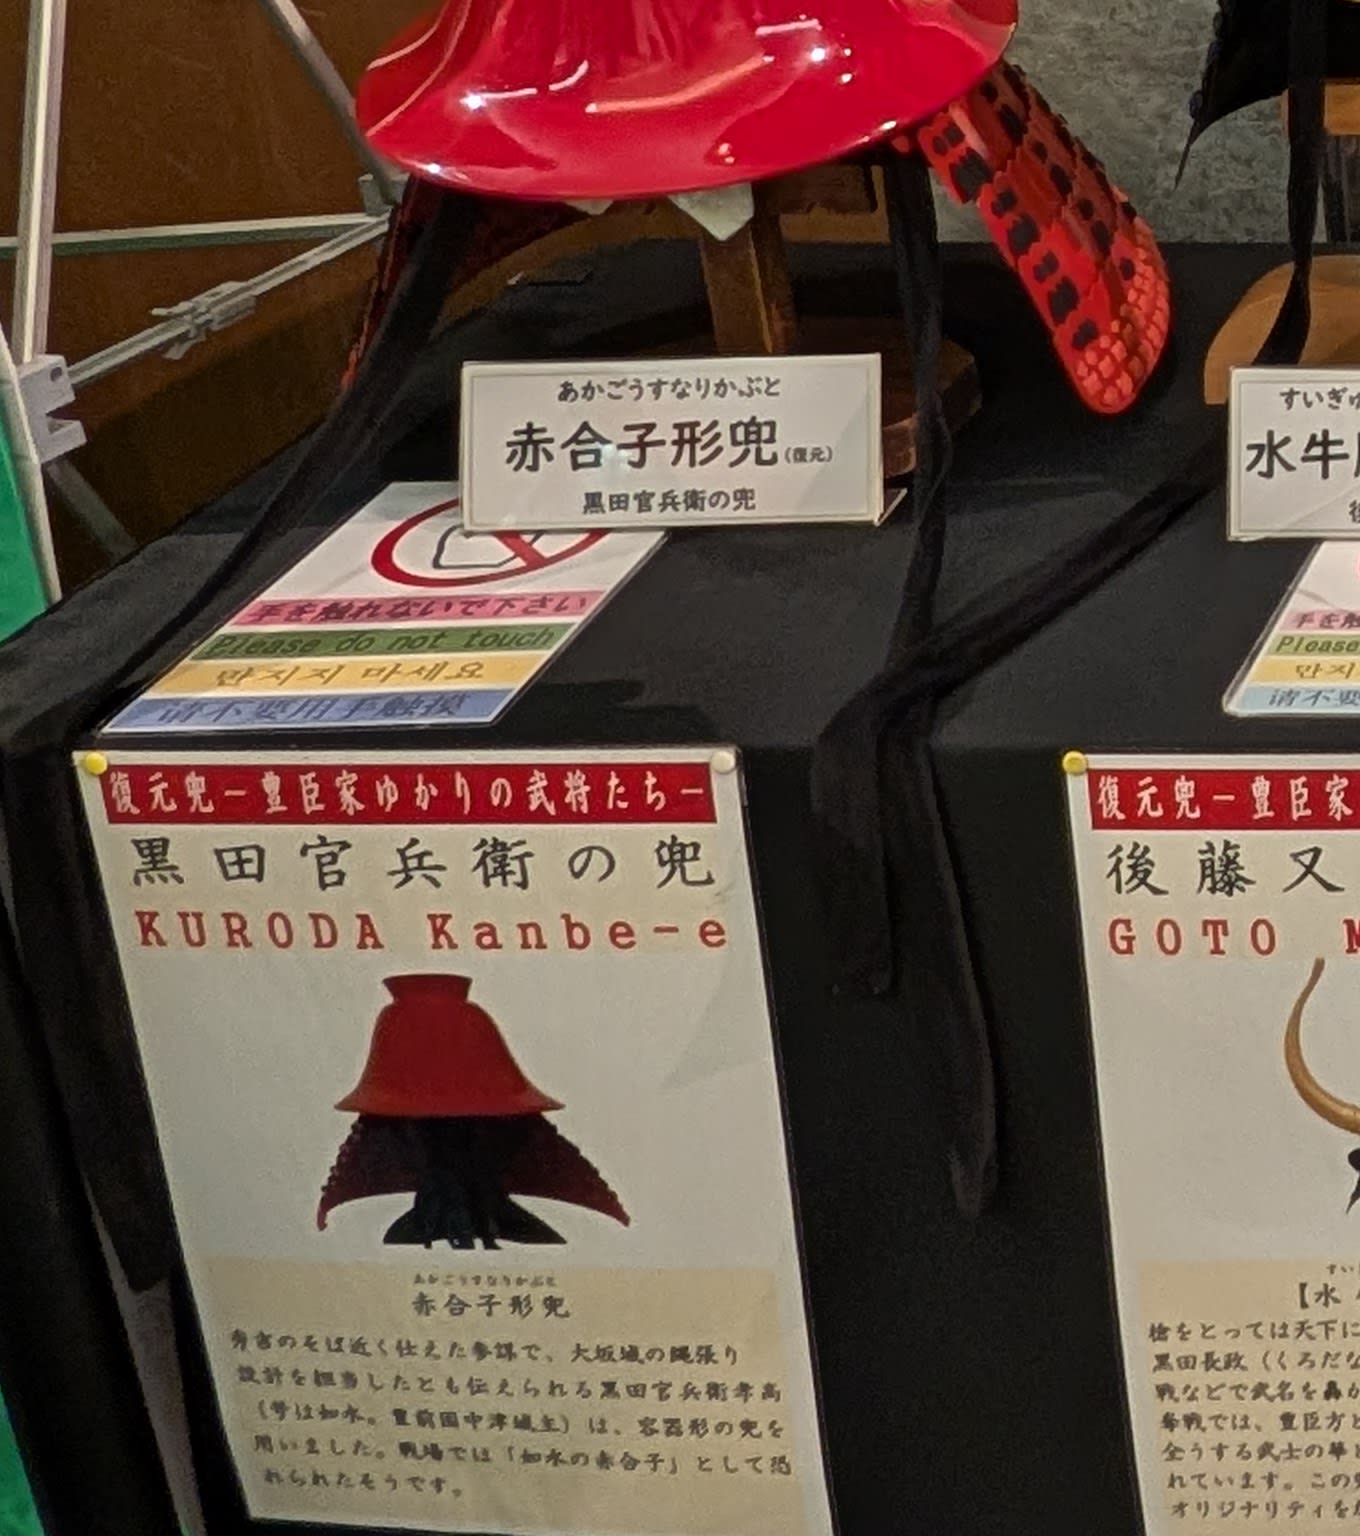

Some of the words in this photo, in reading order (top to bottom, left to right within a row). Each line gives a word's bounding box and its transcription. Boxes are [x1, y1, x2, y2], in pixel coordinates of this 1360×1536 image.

[557, 376, 781, 403] あかごうすなりかぶと
[582, 487, 757, 516] 黒田官兵衛の兜
[246, 595, 588, 625] 手を触れないで下さい
[203, 632, 321, 658] Please
[335, 629, 375, 654] do
[389, 628, 442, 652] not
[463, 626, 555, 650] touch
[1275, 636, 1360, 654] Please
[131, 833, 715, 891] 黒田官兵衛の兜
[135, 910, 386, 950] KURODA
[428, 914, 728, 951] Kanbe-e
[1107, 917, 1279, 957] GOTO
[412, 1290, 571, 1319] 赤合子形兜
